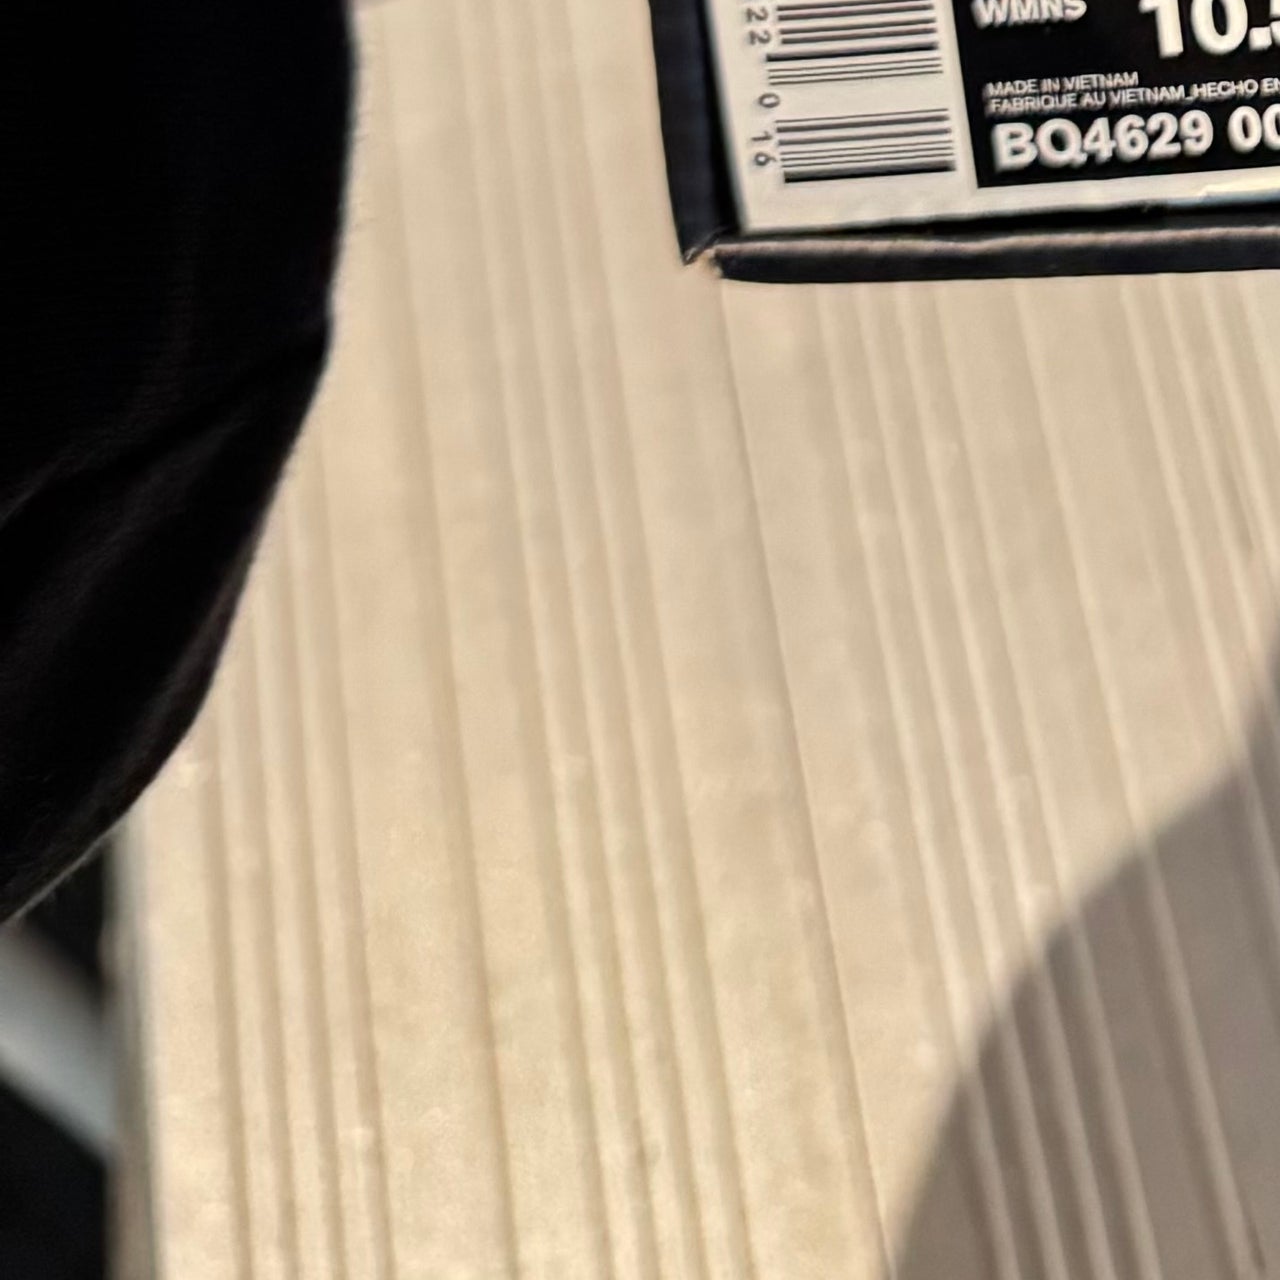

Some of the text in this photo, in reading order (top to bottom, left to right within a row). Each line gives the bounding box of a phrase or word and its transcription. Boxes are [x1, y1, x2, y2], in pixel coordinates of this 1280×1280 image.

[985, 72, 1138, 98] MADE IN VIETNAM
[986, 93, 1077, 116] FABRIQUE
[1081, 90, 1105, 108] AU
[992, 110, 1213, 173] BQ4629
